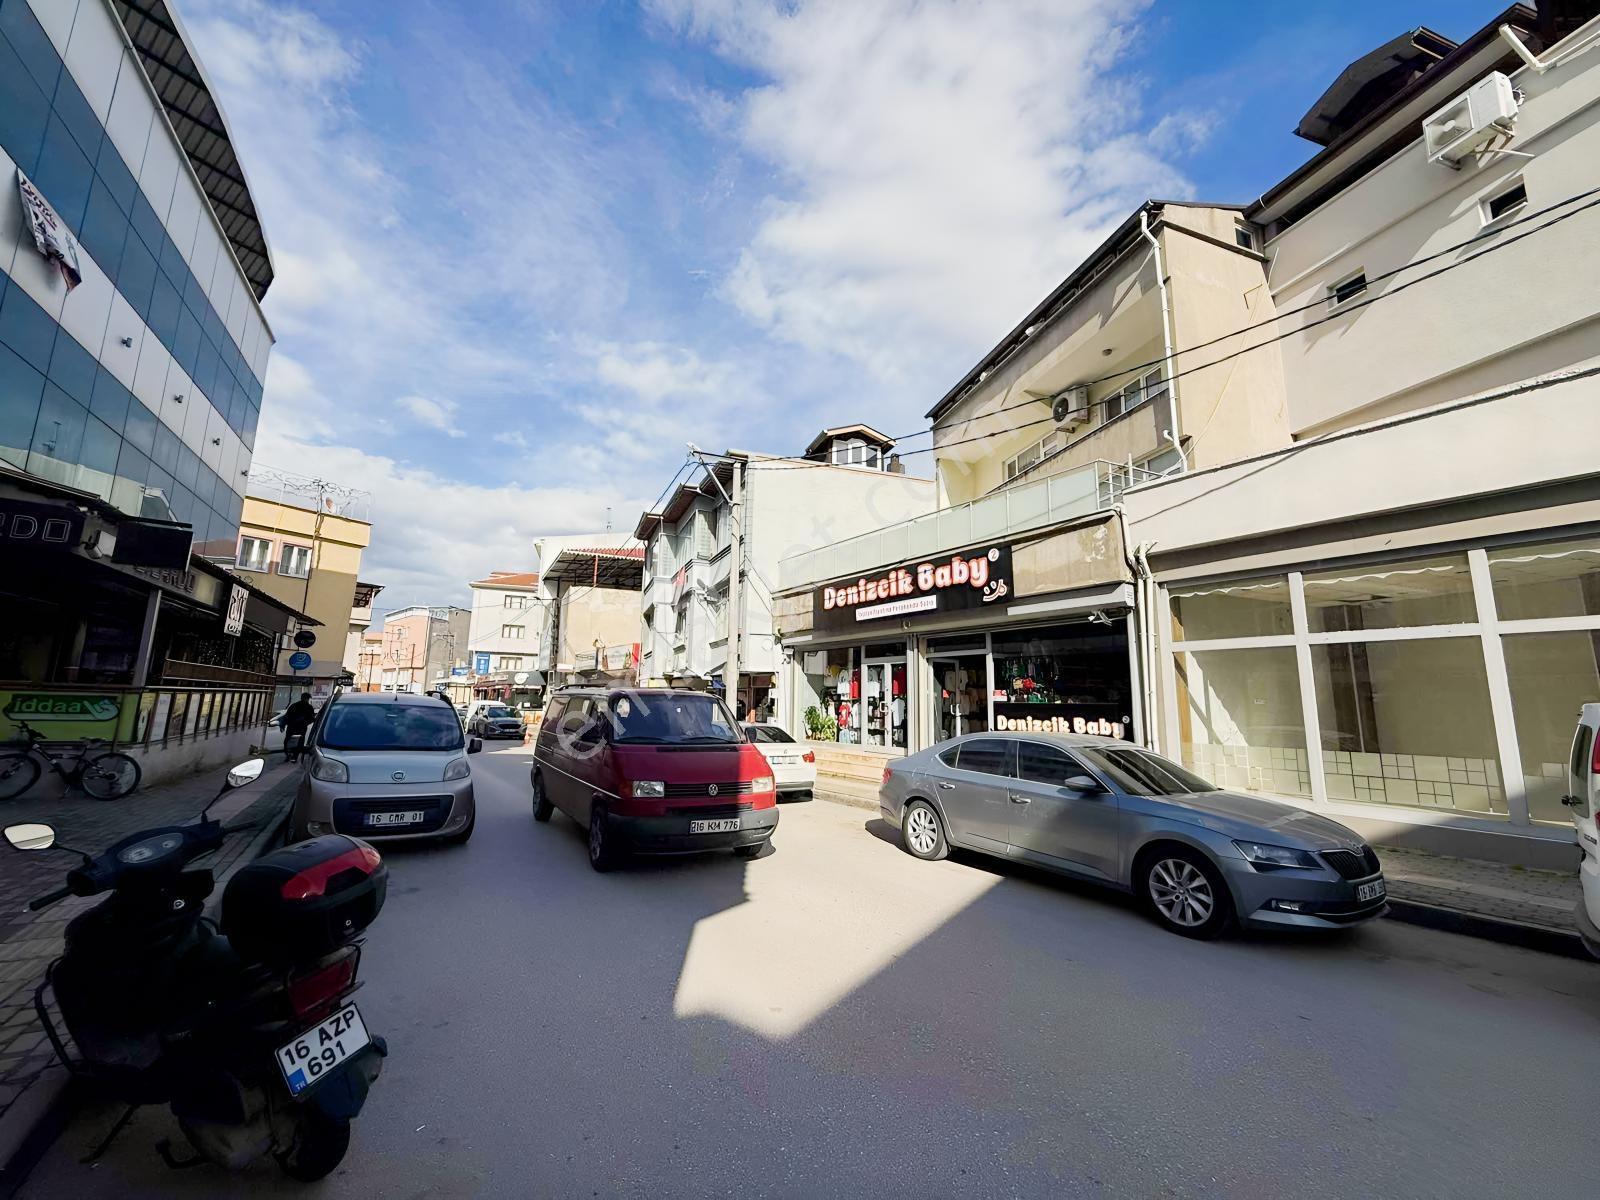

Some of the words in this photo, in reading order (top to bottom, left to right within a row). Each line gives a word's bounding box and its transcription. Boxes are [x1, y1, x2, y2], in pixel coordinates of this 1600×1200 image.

[0, 512, 71, 543] DO
[823, 569, 914, 610] Denizcik
[916, 555, 990, 592] Baby
[14, 698, 81, 713] iddaa
[996, 714, 1070, 733] Denizcik
[1073, 716, 1125, 739] Baby
[723, 820, 738, 831] 776
[285, 1040, 310, 1066] 16
[318, 1009, 355, 1047] AZP
[307, 1039, 346, 1077] 691
